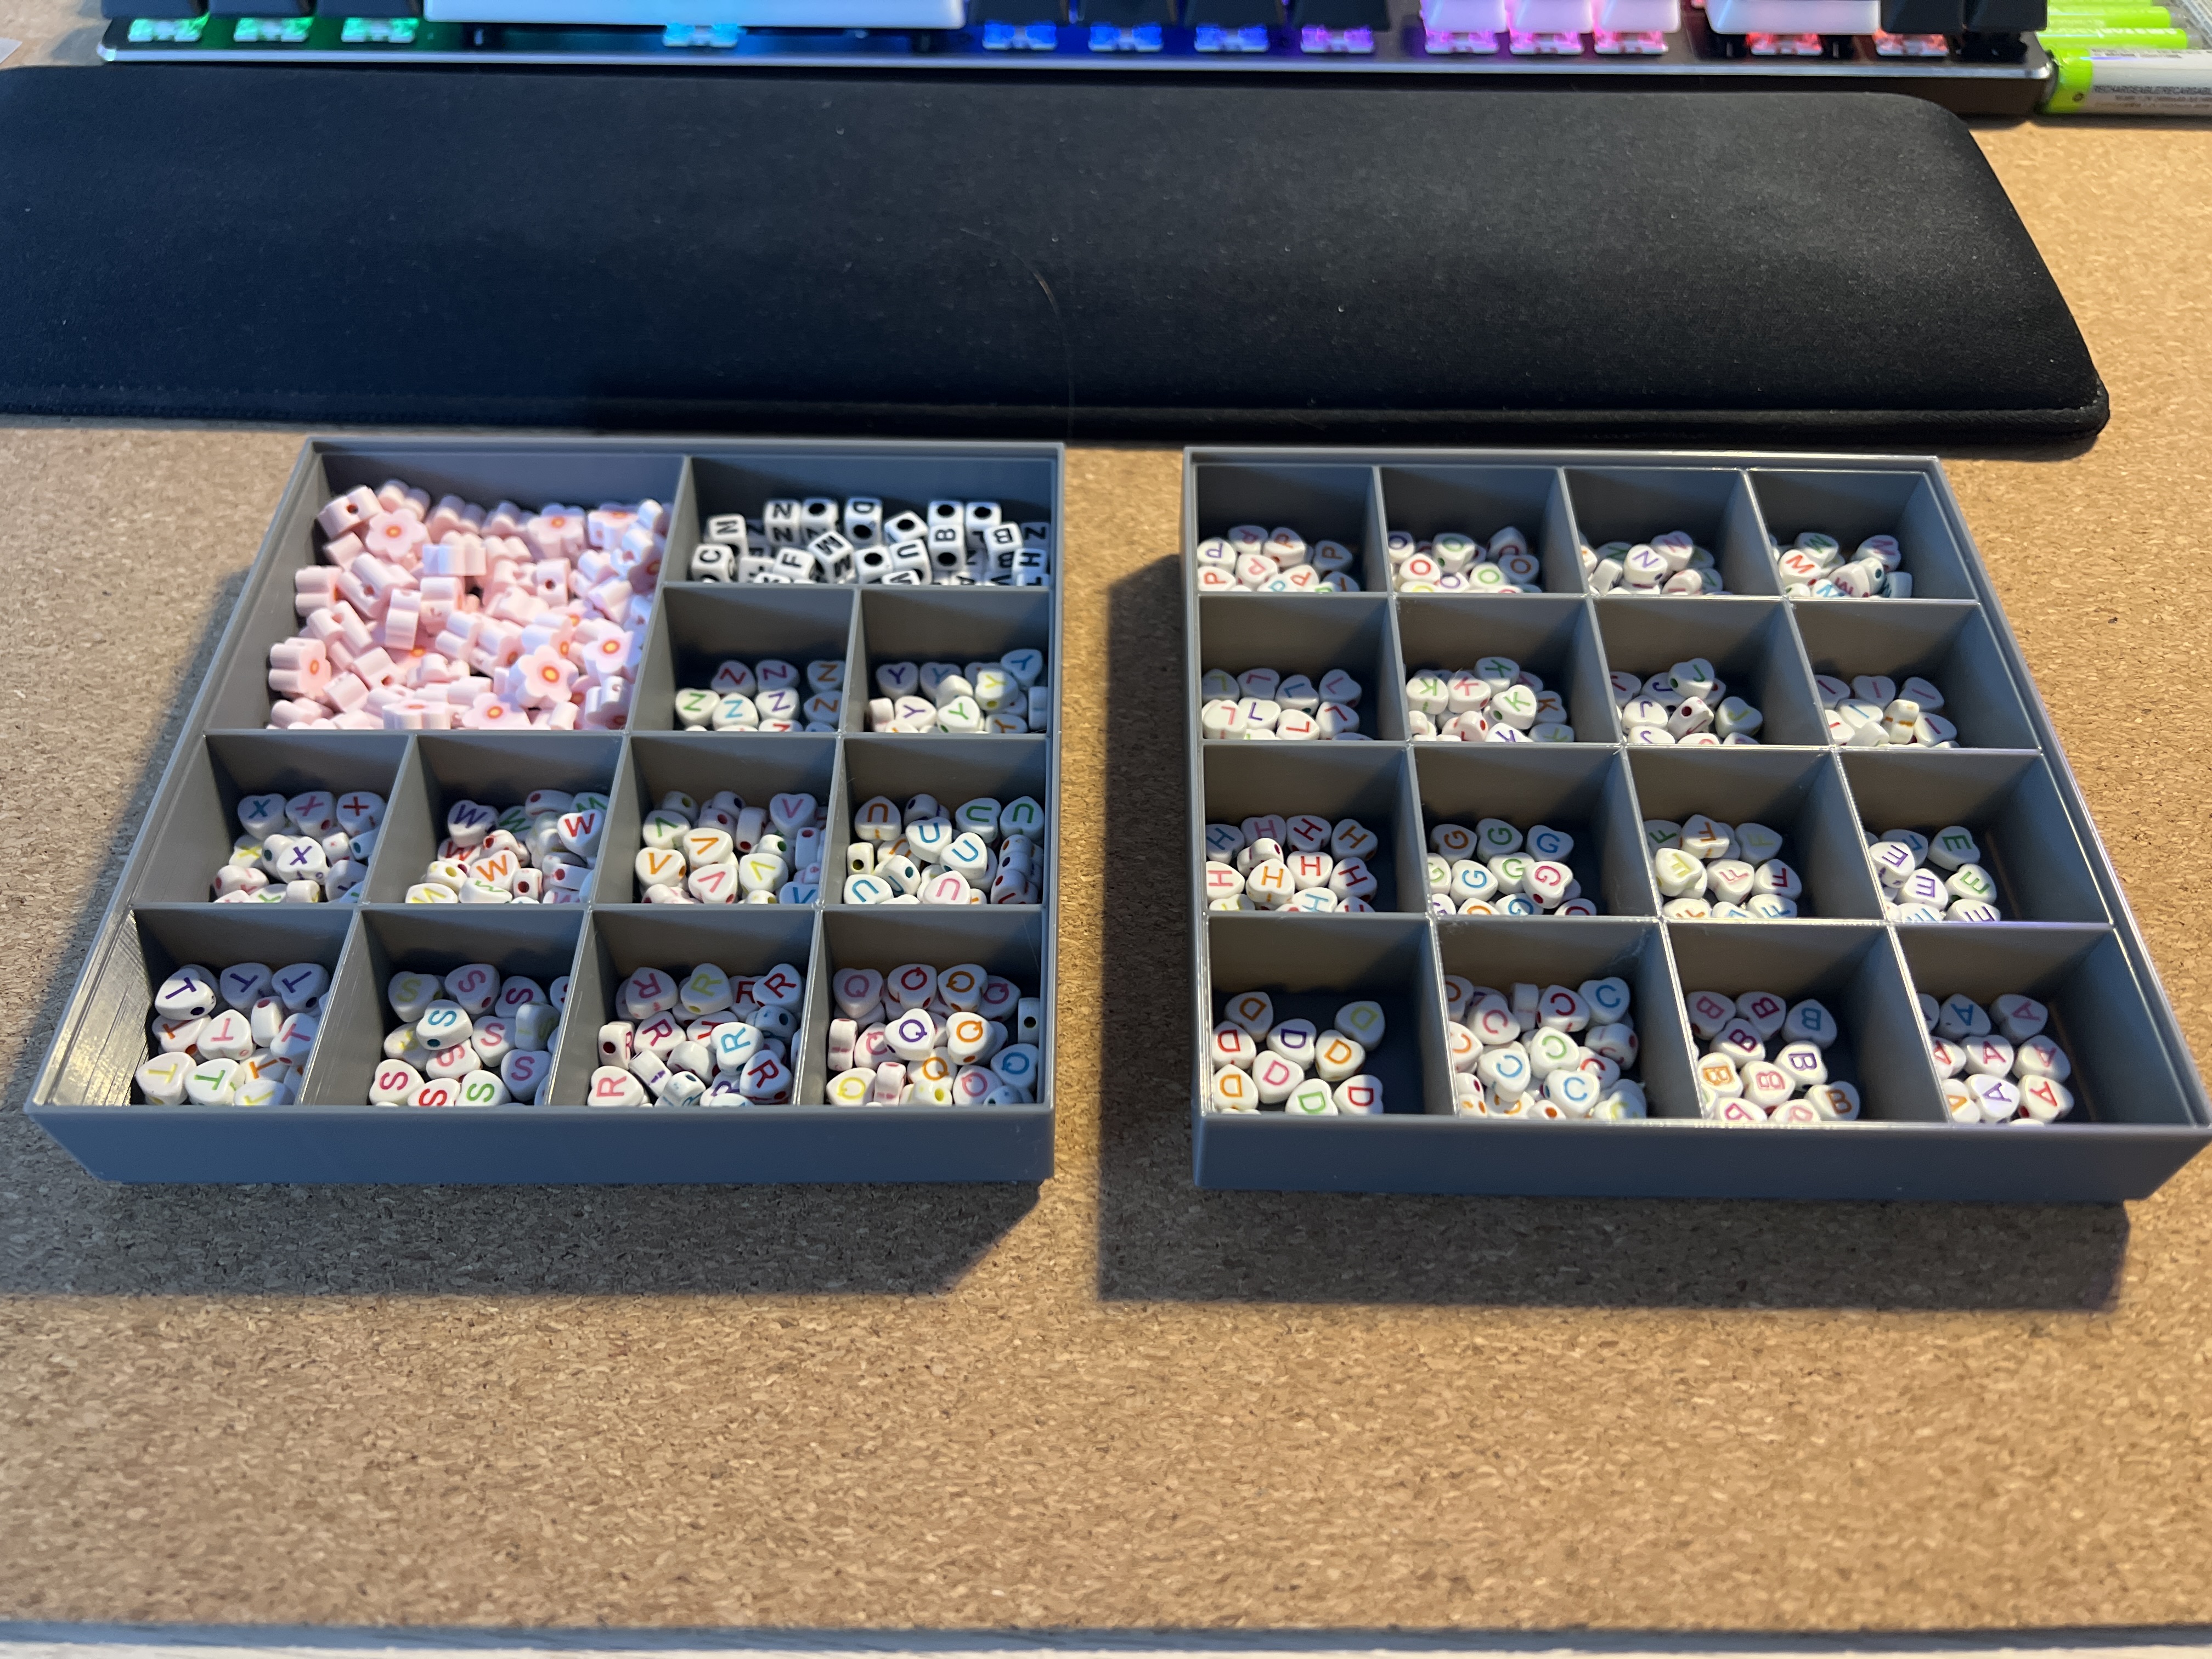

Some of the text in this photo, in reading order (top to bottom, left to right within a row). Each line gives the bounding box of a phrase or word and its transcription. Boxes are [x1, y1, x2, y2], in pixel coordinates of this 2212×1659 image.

[853, 501, 874, 514] D
[935, 529, 956, 541] B
[994, 528, 1013, 544] B
[1274, 533, 1294, 549] P
[1442, 537, 1463, 552] O
[699, 550, 721, 563] C
[781, 554, 802, 568] F
[896, 544, 919, 559] U
[1020, 552, 1041, 567] H
[1205, 543, 1223, 558] P
[1322, 546, 1342, 560] P
[1249, 558, 1266, 575] P
[1410, 559, 1431, 575] O
[1510, 558, 1531, 574] O
[1786, 555, 1815, 573] M
[1204, 572, 1226, 584] P
[1290, 572, 1311, 586] P
[1477, 568, 1499, 584] O
[817, 664, 838, 681] Z
[1011, 655, 1034, 670] Y
[1485, 659, 1511, 678] K
[1692, 664, 1706, 682] J
[888, 667, 905, 684] Y
[985, 674, 1006, 688] Y
[1453, 676, 1479, 696] K
[1420, 678, 1437, 696] K
[684, 692, 707, 711] Z
[724, 699, 743, 718] Z
[769, 692, 790, 712] Z
[904, 705, 926, 718] Y
[949, 703, 969, 720] Y
[1248, 702, 1262, 721] L
[1504, 692, 1531, 712] K
[1538, 698, 1558, 713] K
[249, 799, 271, 819] X
[295, 796, 324, 816] X
[343, 796, 369, 816] X
[454, 804, 489, 828] W
[782, 798, 804, 819] V
[565, 813, 595, 837] W
[918, 822, 940, 843] U
[1254, 820, 1277, 839] H
[1294, 818, 1323, 841] H
[1699, 822, 1716, 842] F
[1206, 827, 1234, 850] H
[1338, 825, 1368, 849] H
[1443, 830, 1469, 849] G
[1487, 827, 1513, 845] G
[1537, 833, 1560, 853] G
[1649, 830, 1677, 843] F
[1942, 835, 1972, 851] E
[290, 846, 312, 865] X
[952, 840, 979, 862] U
[1882, 845, 1908, 867] E
[476, 855, 507, 882] W
[649, 853, 673, 874] V
[1301, 856, 1321, 876] H
[1208, 870, 1233, 887] H
[1261, 866, 1283, 888] H
[1338, 865, 1368, 887] H
[1462, 870, 1487, 888] G
[1536, 866, 1561, 886] G
[1719, 869, 1749, 882] F
[1771, 868, 1788, 887] F
[1960, 871, 1990, 894] E
[1916, 876, 1935, 898] E
[165, 978, 196, 1000] T
[230, 973, 258, 992] T
[282, 971, 312, 993] T
[458, 970, 486, 992] S
[633, 973, 662, 998] R
[691, 973, 723, 997] R
[764, 973, 797, 998] R
[844, 974, 869, 998] Q
[901, 967, 927, 990] Q
[946, 971, 974, 993] Q
[396, 978, 422, 1002] S
[505, 988, 533, 1005] S
[983, 983, 1009, 1004] Q
[1595, 985, 1621, 1008] C
[1239, 997, 1267, 1021] D
[1550, 992, 1576, 1015] C
[1696, 996, 1725, 1019] B
[1751, 997, 1780, 1019] B
[2012, 1001, 2041, 1021] A
[428, 1010, 457, 1027] S
[1350, 1006, 1378, 1030] D
[1483, 1009, 1508, 1034] C
[1802, 1007, 1821, 1031] B
[1950, 1003, 1973, 1026] A
[211, 1018, 234, 1042] T
[281, 1023, 311, 1042] T
[481, 1023, 505, 1046] S
[642, 1019, 673, 1046] R
[720, 1027, 750, 1053] R
[899, 1019, 927, 1042] Q
[956, 1020, 983, 1043] Q
[1217, 1029, 1240, 1052] D
[1281, 1028, 1307, 1048] D
[1324, 1039, 1352, 1064] D
[1542, 1036, 1567, 1059] C
[1729, 1029, 1757, 1053] B
[436, 1044, 465, 1067] S
[1789, 1053, 1817, 1071] B
[1983, 1041, 2006, 1064] A
[2034, 1044, 2057, 1067] A
[146, 1064, 178, 1084] T
[511, 1056, 535, 1081] S
[748, 1059, 779, 1088] R
[922, 1057, 949, 1081] Q
[1002, 1052, 1029, 1075] Q
[1263, 1060, 1289, 1085] D
[1496, 1055, 1522, 1077] C
[194, 1070, 225, 1090] T
[379, 1071, 408, 1091] S
[961, 1073, 988, 1097] Q
[1220, 1074, 1242, 1097] D
[1703, 1065, 1733, 1086] B
[1756, 1071, 1785, 1091] B
[466, 1084, 494, 1103] S
[596, 1076, 627, 1097] R
[837, 1077, 866, 1099] Q
[1348, 1086, 1374, 1107] D
[1564, 1076, 1587, 1102] C
[1983, 1082, 2012, 1103] A
[2030, 1081, 2057, 1107] A
[1297, 1091, 1325, 1114] D
[1826, 1090, 1852, 1114] B
